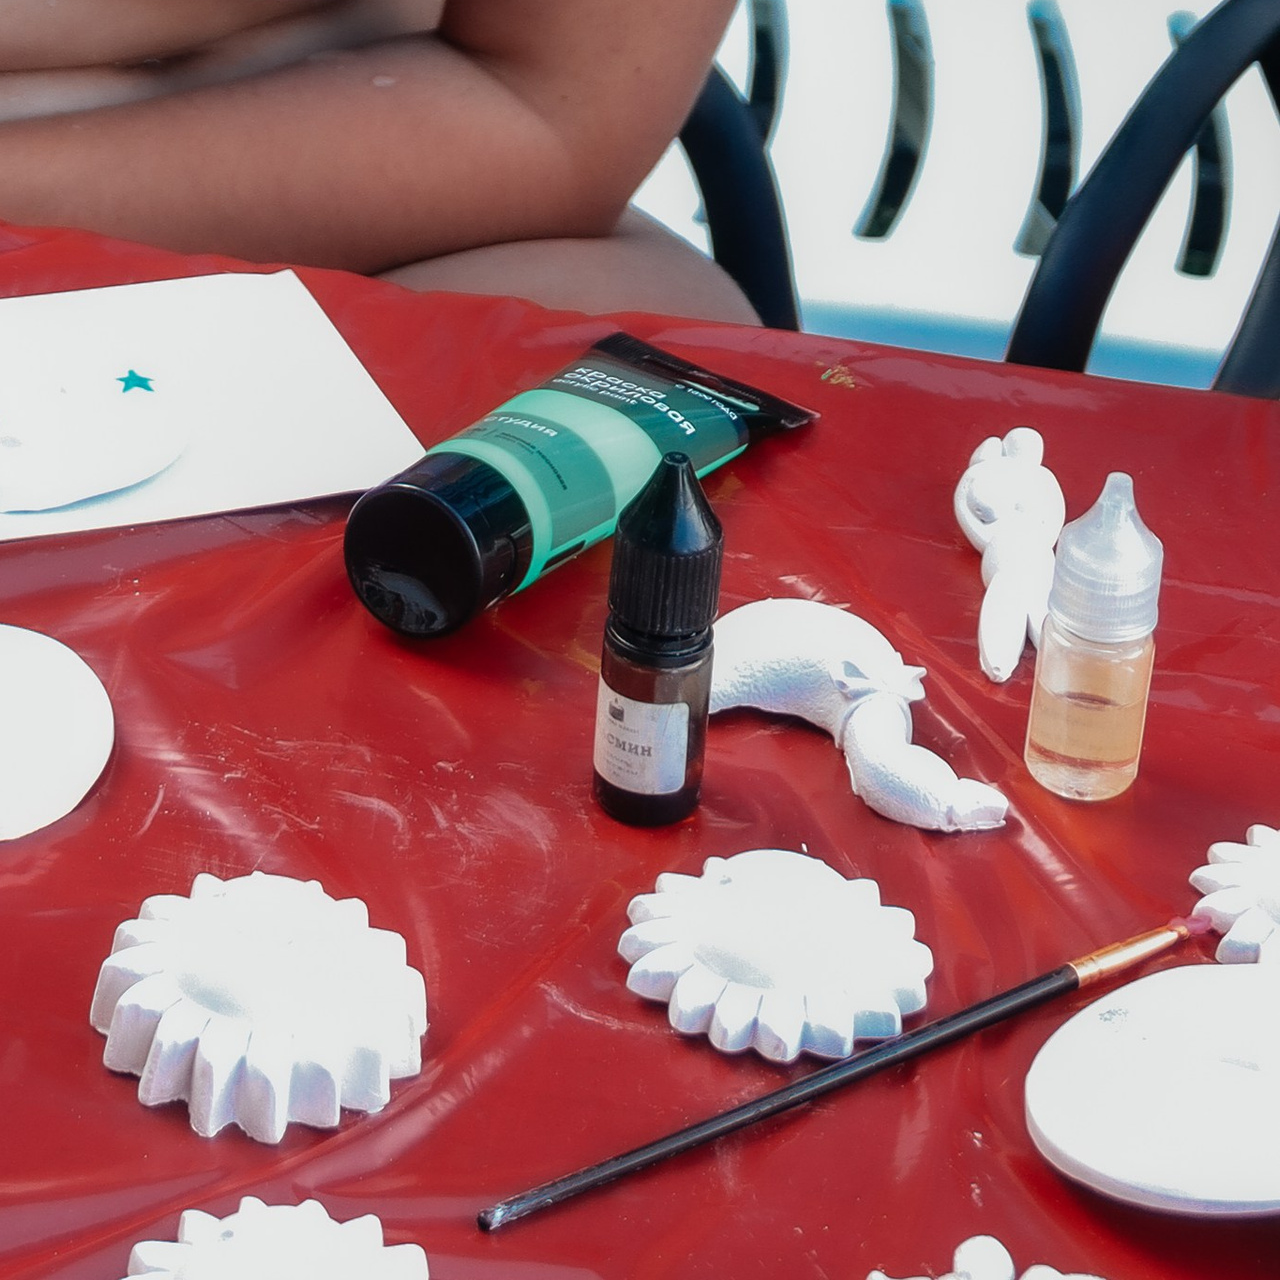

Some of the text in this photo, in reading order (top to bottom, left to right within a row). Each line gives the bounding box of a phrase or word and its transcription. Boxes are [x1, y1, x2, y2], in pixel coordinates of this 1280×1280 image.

[574, 366, 667, 399] краска
[598, 388, 639, 406] paint
[563, 372, 697, 436] акриловая
